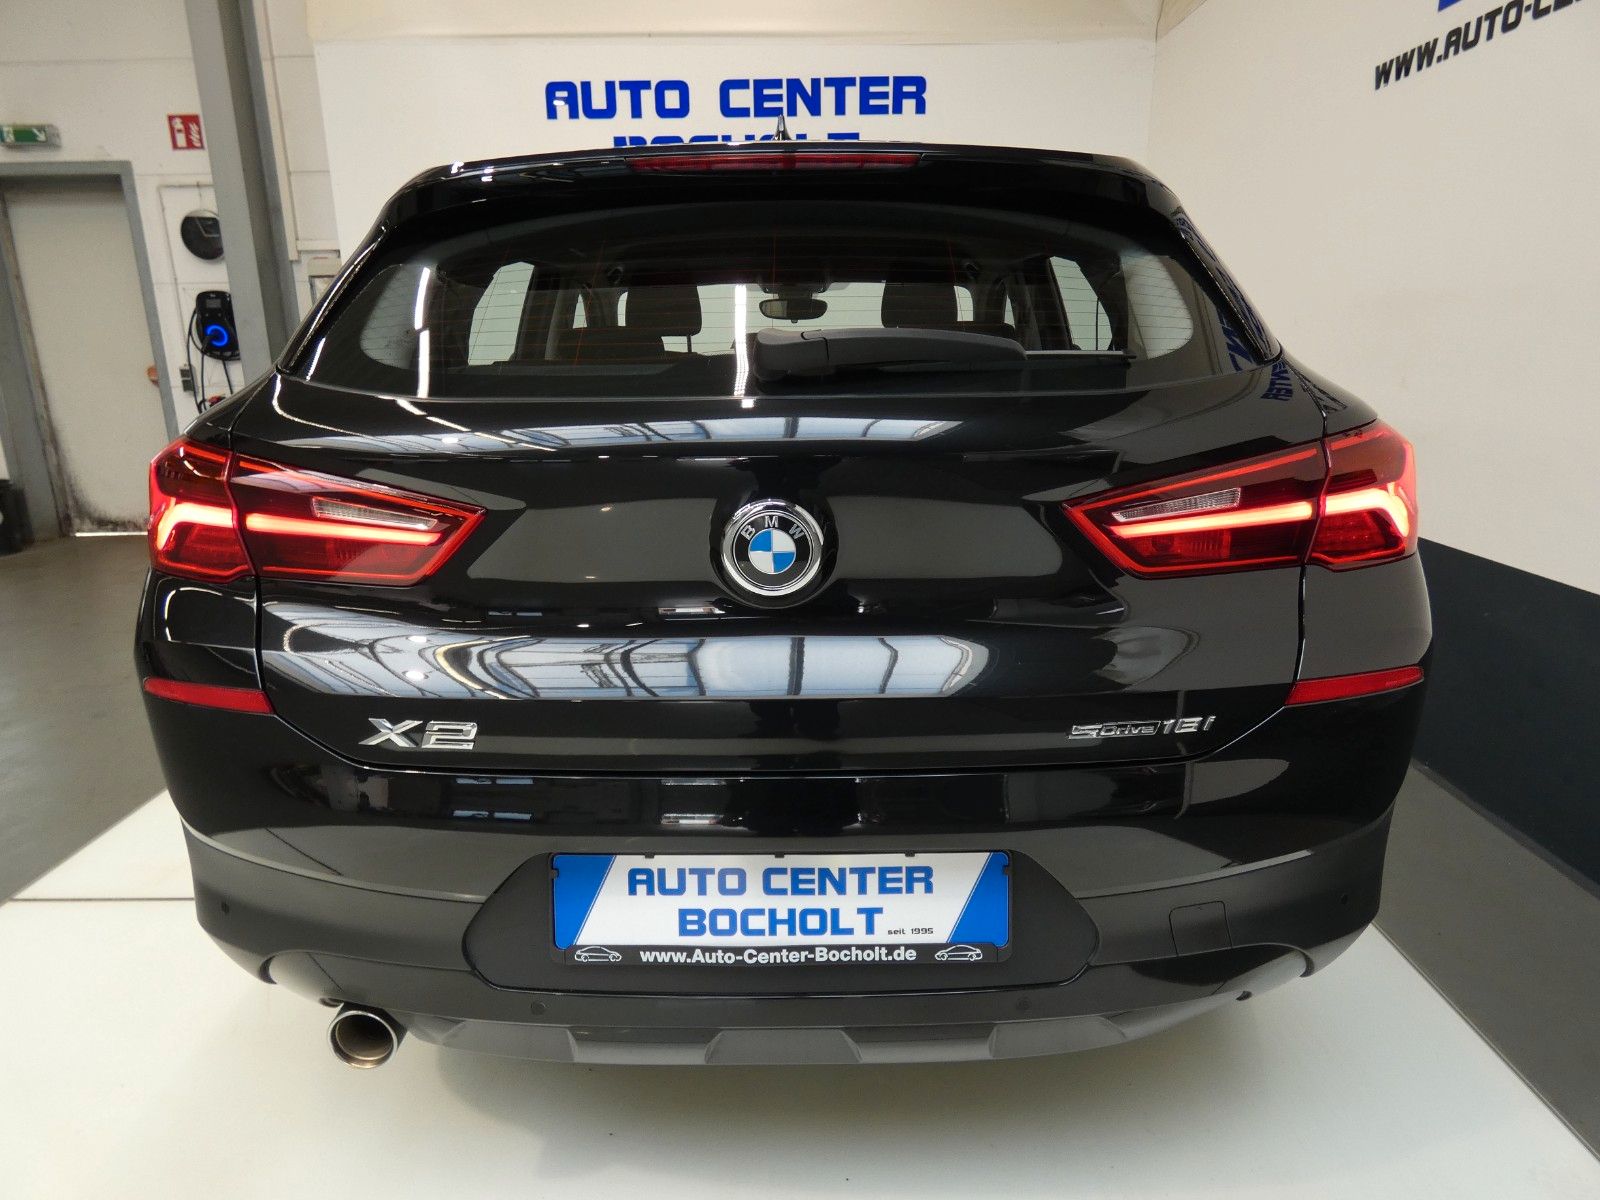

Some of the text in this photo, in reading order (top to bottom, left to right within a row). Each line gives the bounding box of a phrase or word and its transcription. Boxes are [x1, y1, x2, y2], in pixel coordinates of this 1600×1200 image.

[1374, 0, 1581, 90] WWW.AUTO-C
[545, 76, 927, 120] AUTO CENTER
[740, 515, 805, 541] BMW
[358, 717, 478, 750] X2
[627, 866, 934, 896] AUTO CENTER
[678, 907, 884, 937] BOCHOLT
[911, 927, 934, 935] 1995
[639, 946, 917, 963] www.Auto-Center-Bocholt.de
